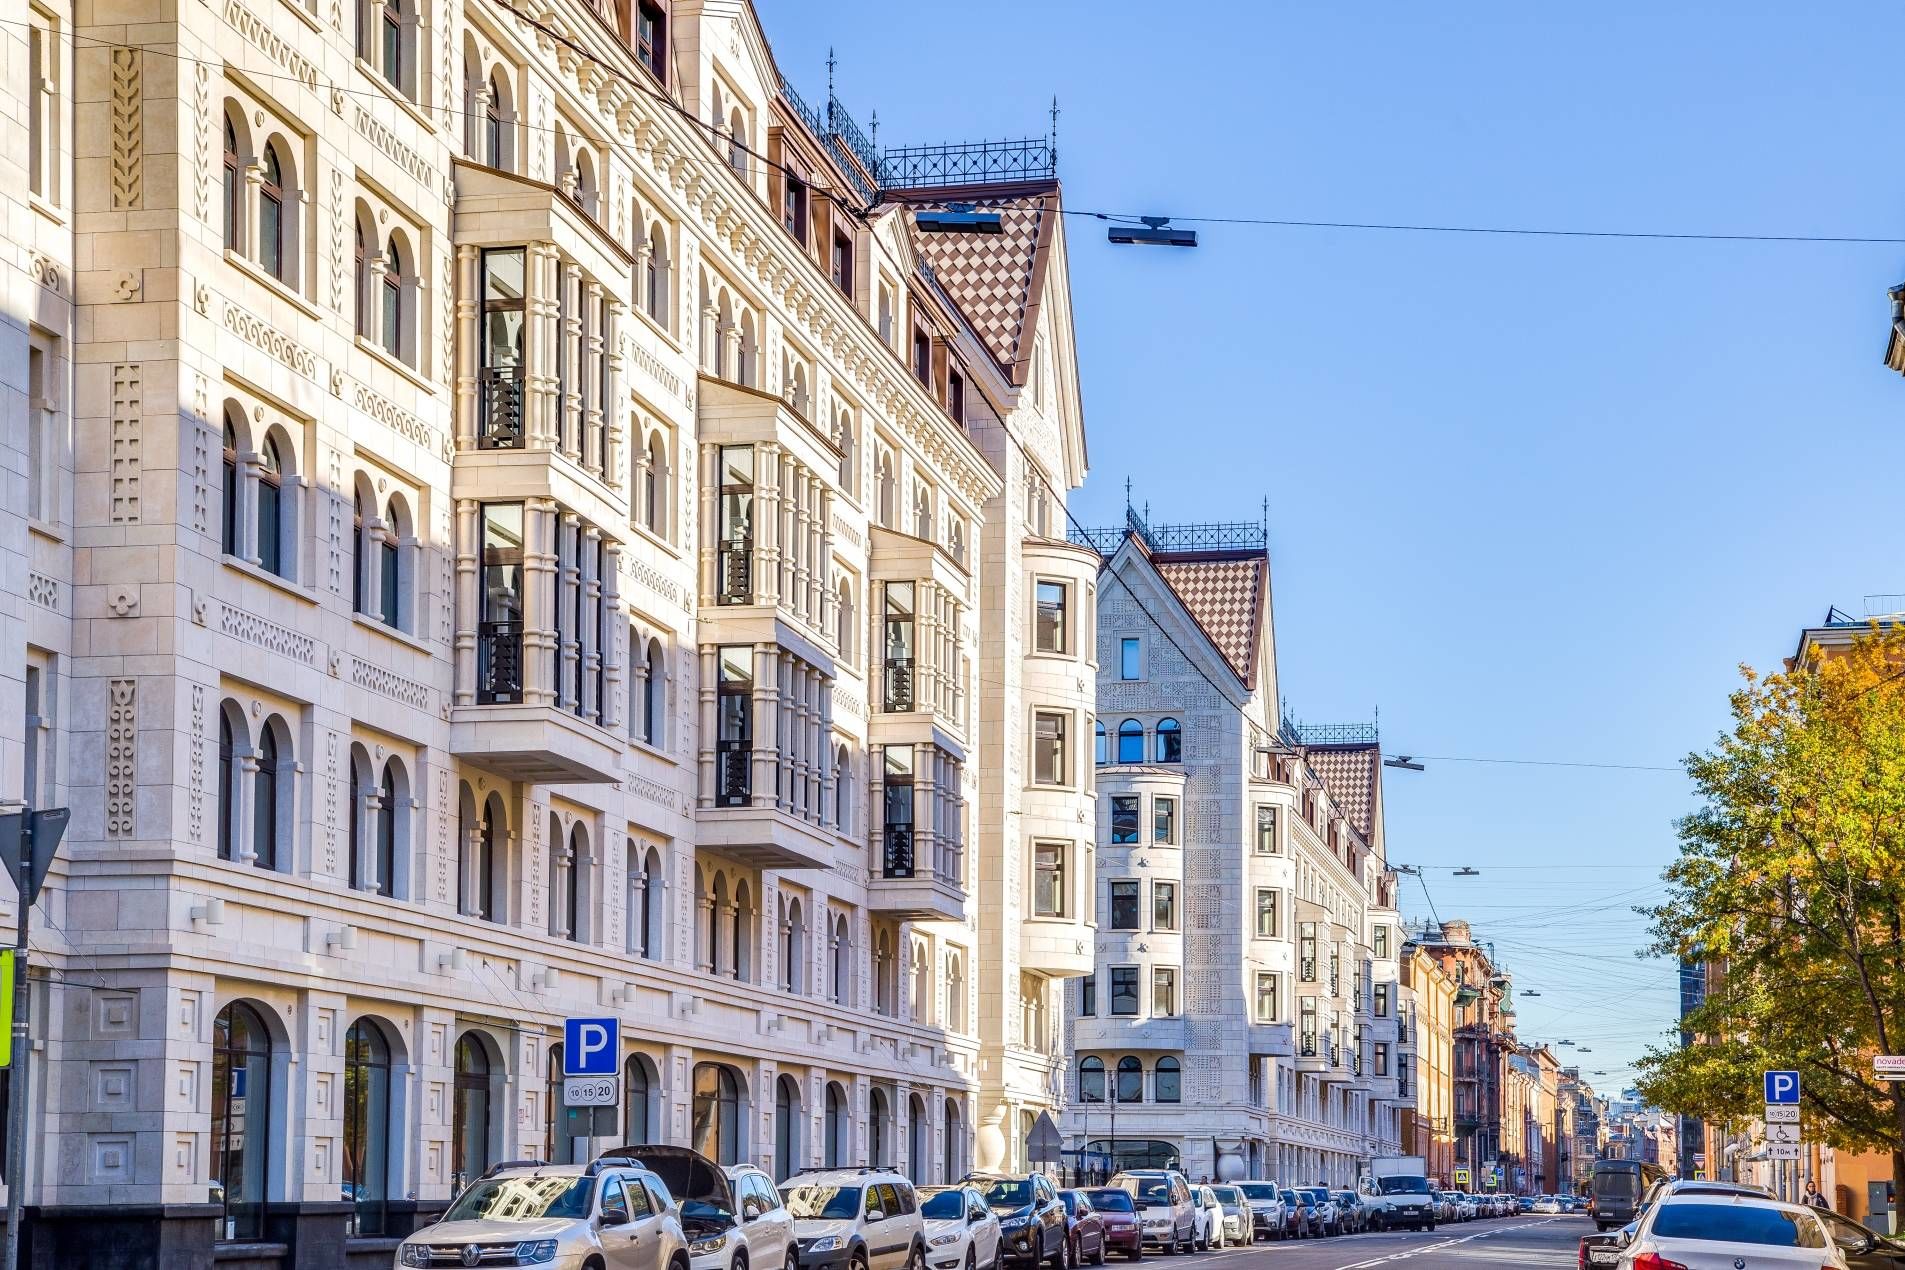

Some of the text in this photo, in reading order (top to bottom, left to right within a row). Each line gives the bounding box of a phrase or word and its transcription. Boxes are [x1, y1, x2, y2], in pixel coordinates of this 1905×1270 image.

[579, 1024, 608, 1069] P
[584, 1089, 594, 1097] 15
[598, 1086, 611, 1097] 20
[1774, 1075, 1793, 1100] P
[1785, 1110, 1796, 1118] 20
